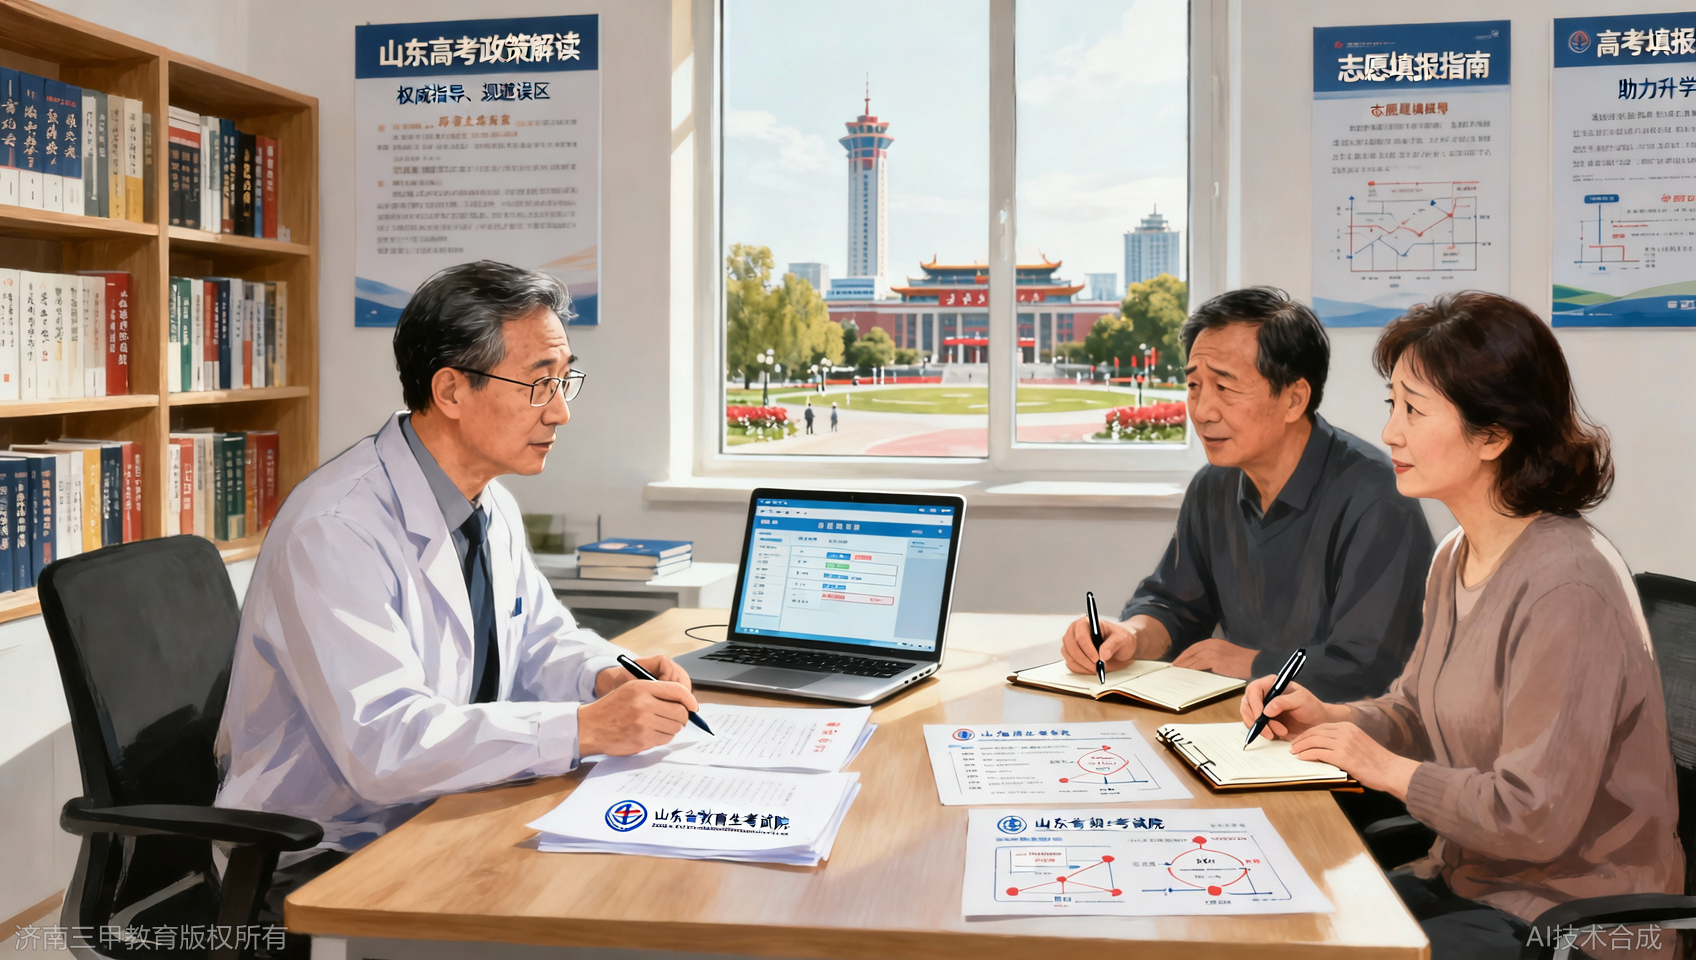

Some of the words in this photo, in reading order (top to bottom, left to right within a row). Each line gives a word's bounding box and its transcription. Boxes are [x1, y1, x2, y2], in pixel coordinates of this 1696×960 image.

[379, 31, 580, 67] 山东高考政策解读
[1596, 27, 1696, 58] 高考填报
[1338, 51, 1491, 82] 志愿填报指南
